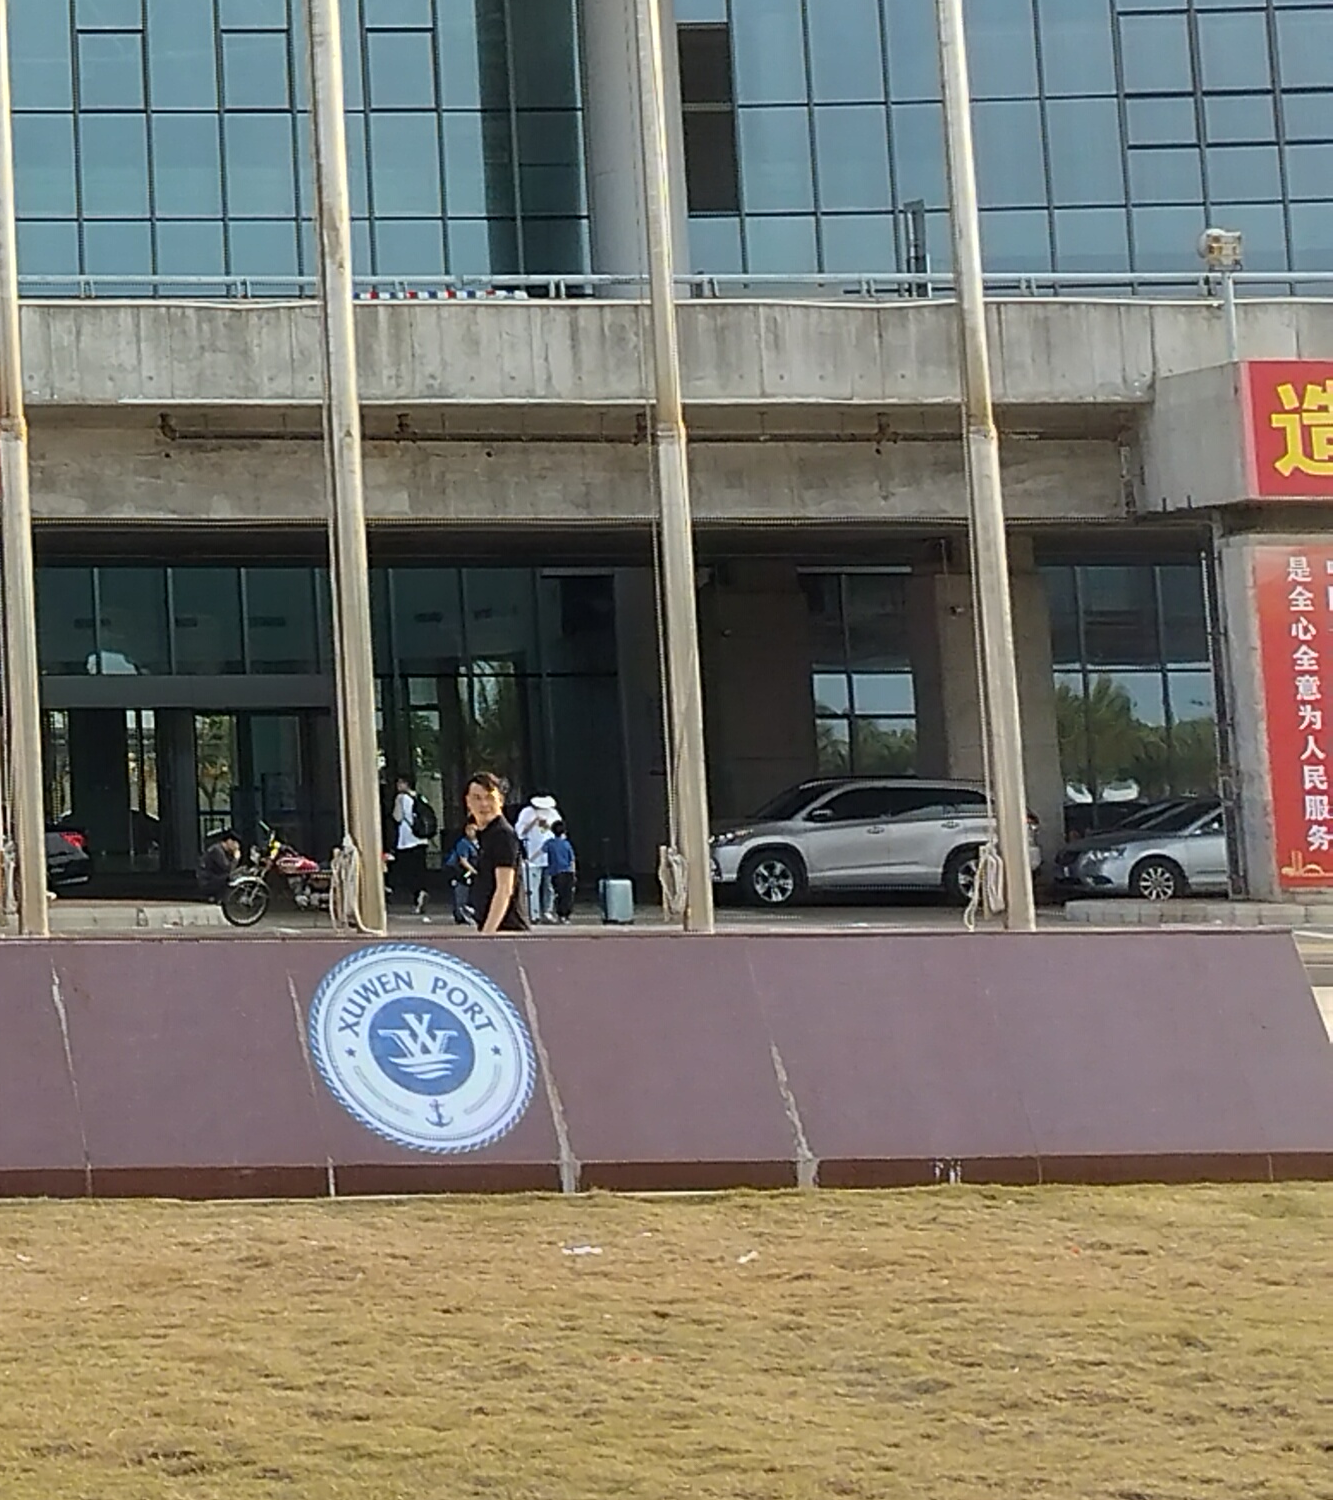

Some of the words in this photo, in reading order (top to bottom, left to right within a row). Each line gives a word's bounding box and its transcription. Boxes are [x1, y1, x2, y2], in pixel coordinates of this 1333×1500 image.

[1286, 556, 1333, 851] 是全心全意为人民服务
[338, 971, 415, 1037] XUWEN
[431, 977, 497, 1032] PORT
